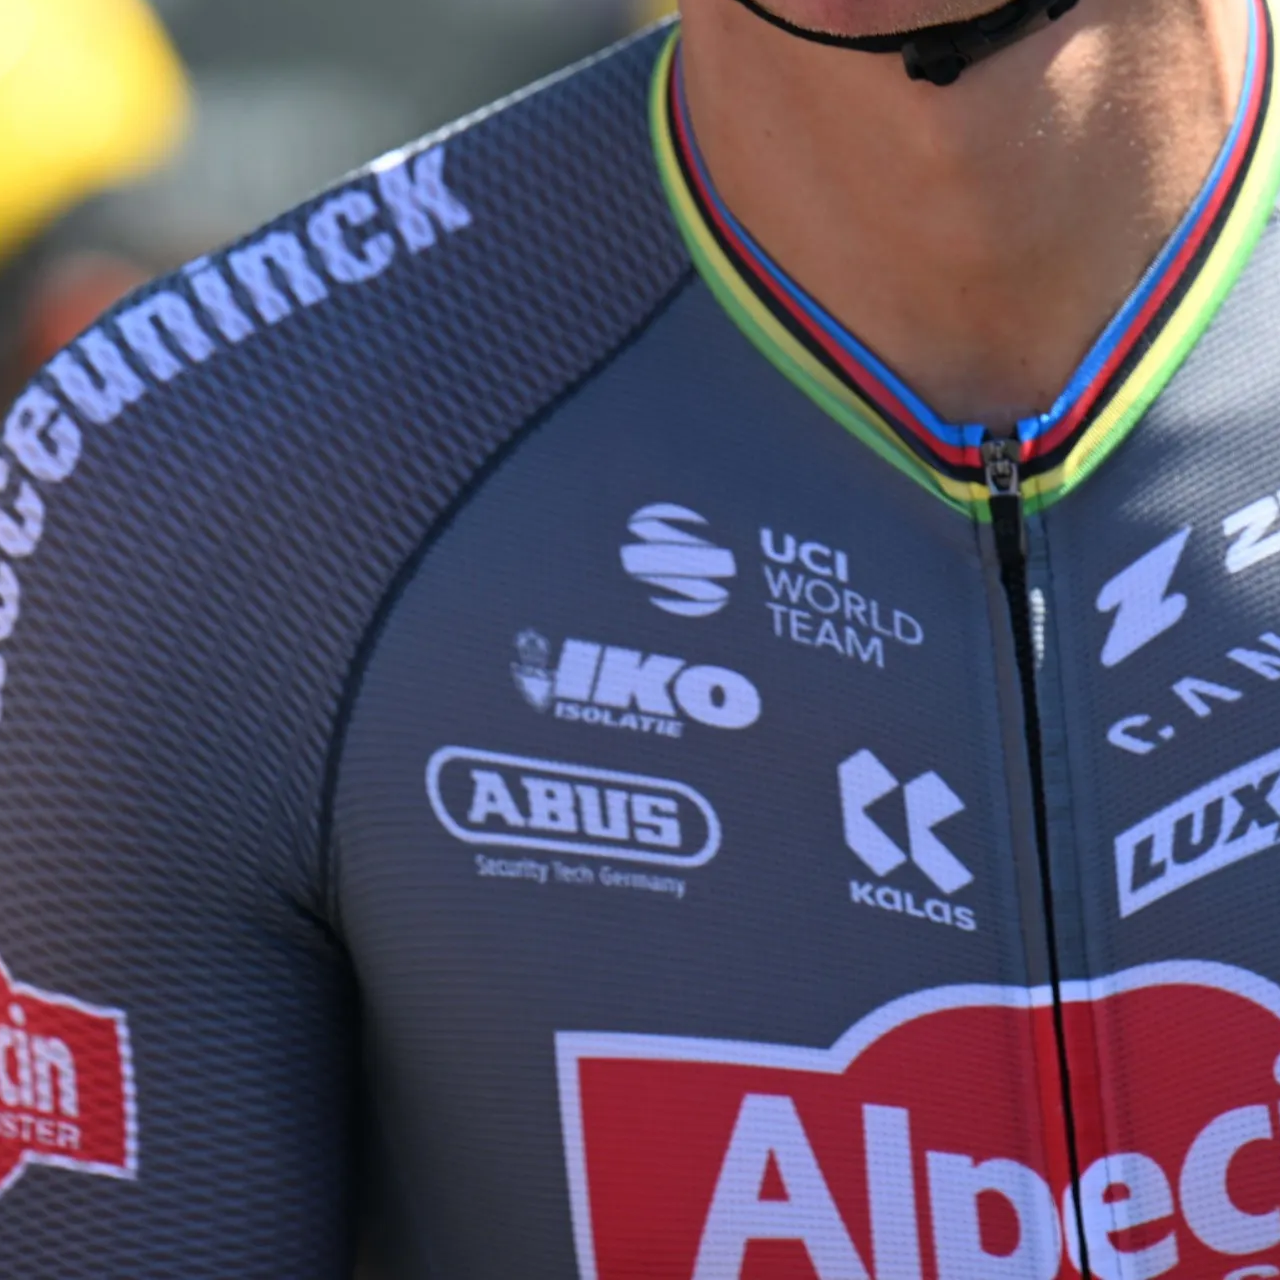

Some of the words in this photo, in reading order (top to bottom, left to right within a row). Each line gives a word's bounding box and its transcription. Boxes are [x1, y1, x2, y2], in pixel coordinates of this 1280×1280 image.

[760, 527, 848, 583] UCI
[763, 563, 924, 645] WORLD
[765, 601, 885, 669] TEAM
[553, 637, 762, 730] IKO
[553, 701, 686, 739] ISOLATIE
[467, 769, 682, 848] ABUS
[475, 853, 549, 885] Security
[552, 860, 595, 885] Tech
[598, 865, 687, 900] Germany
